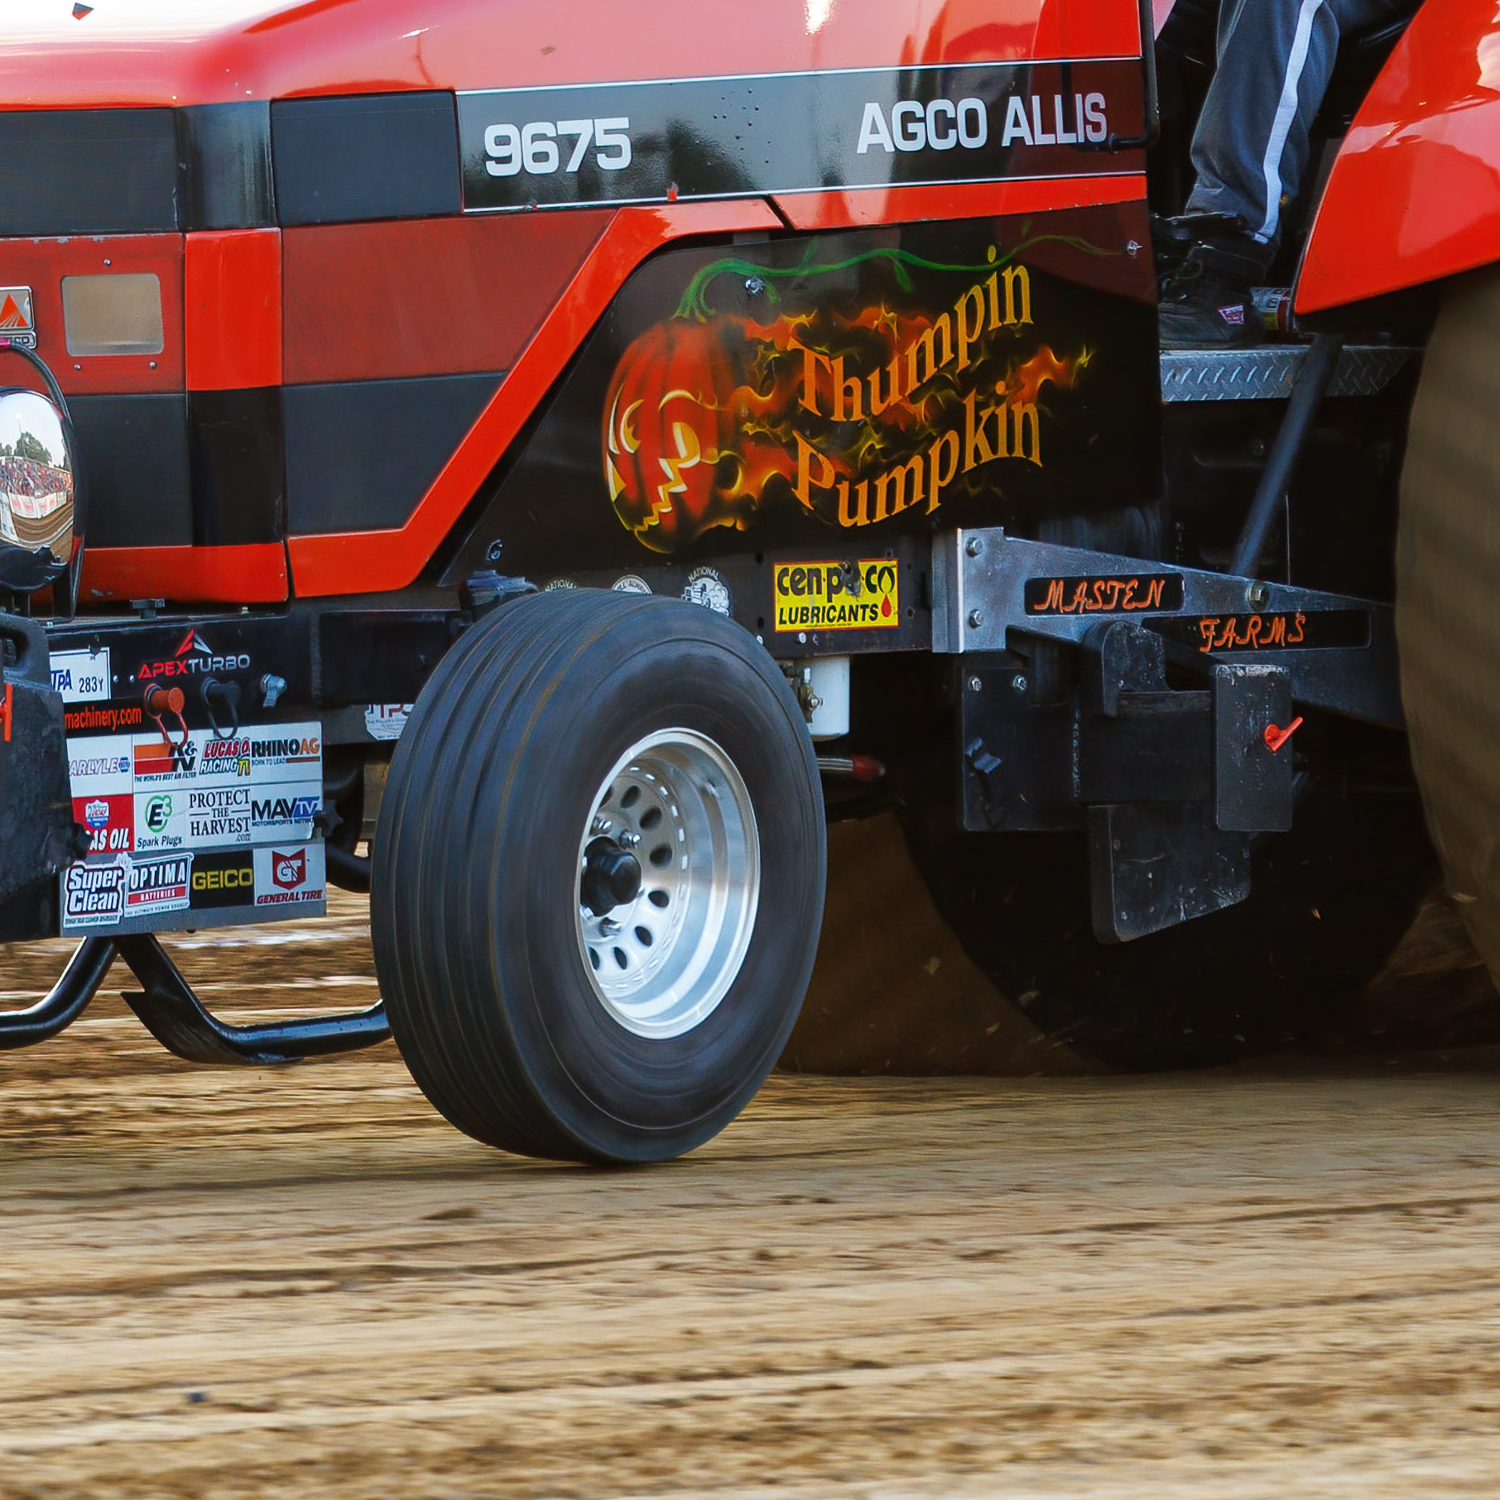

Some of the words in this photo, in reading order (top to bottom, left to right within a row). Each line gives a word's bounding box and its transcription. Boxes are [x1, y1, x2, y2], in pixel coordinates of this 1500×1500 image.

[857, 100, 988, 154] AGCO
[1000, 92, 1108, 148] ALLIS
[484, 116, 632, 178] 9675
[787, 245, 1034, 423] Thumpin
[791, 380, 1043, 528] Pumpkin
[688, 566, 720, 584] NATIONAL
[1034, 578, 1166, 614] MASTEN
[779, 603, 879, 625] LUBRICANTS
[1200, 614, 1306, 652] FARMS
[200, 759, 237, 775] RACING
[189, 788, 250, 809] PROTECT
[211, 807, 229, 818] THE
[190, 816, 250, 836] HARVEST
[109, 828, 130, 850] OIL
[137, 838, 159, 849] Spark
[161, 835, 182, 847] Plugs
[68, 867, 123, 893] Super
[130, 861, 186, 890] OPTIMA
[192, 868, 254, 890] GEICO
[68, 889, 119, 913] Clean
[140, 889, 176, 902] BATTERIES
[256, 891, 300, 904] GENERAL
[301, 889, 323, 901] TIRE
